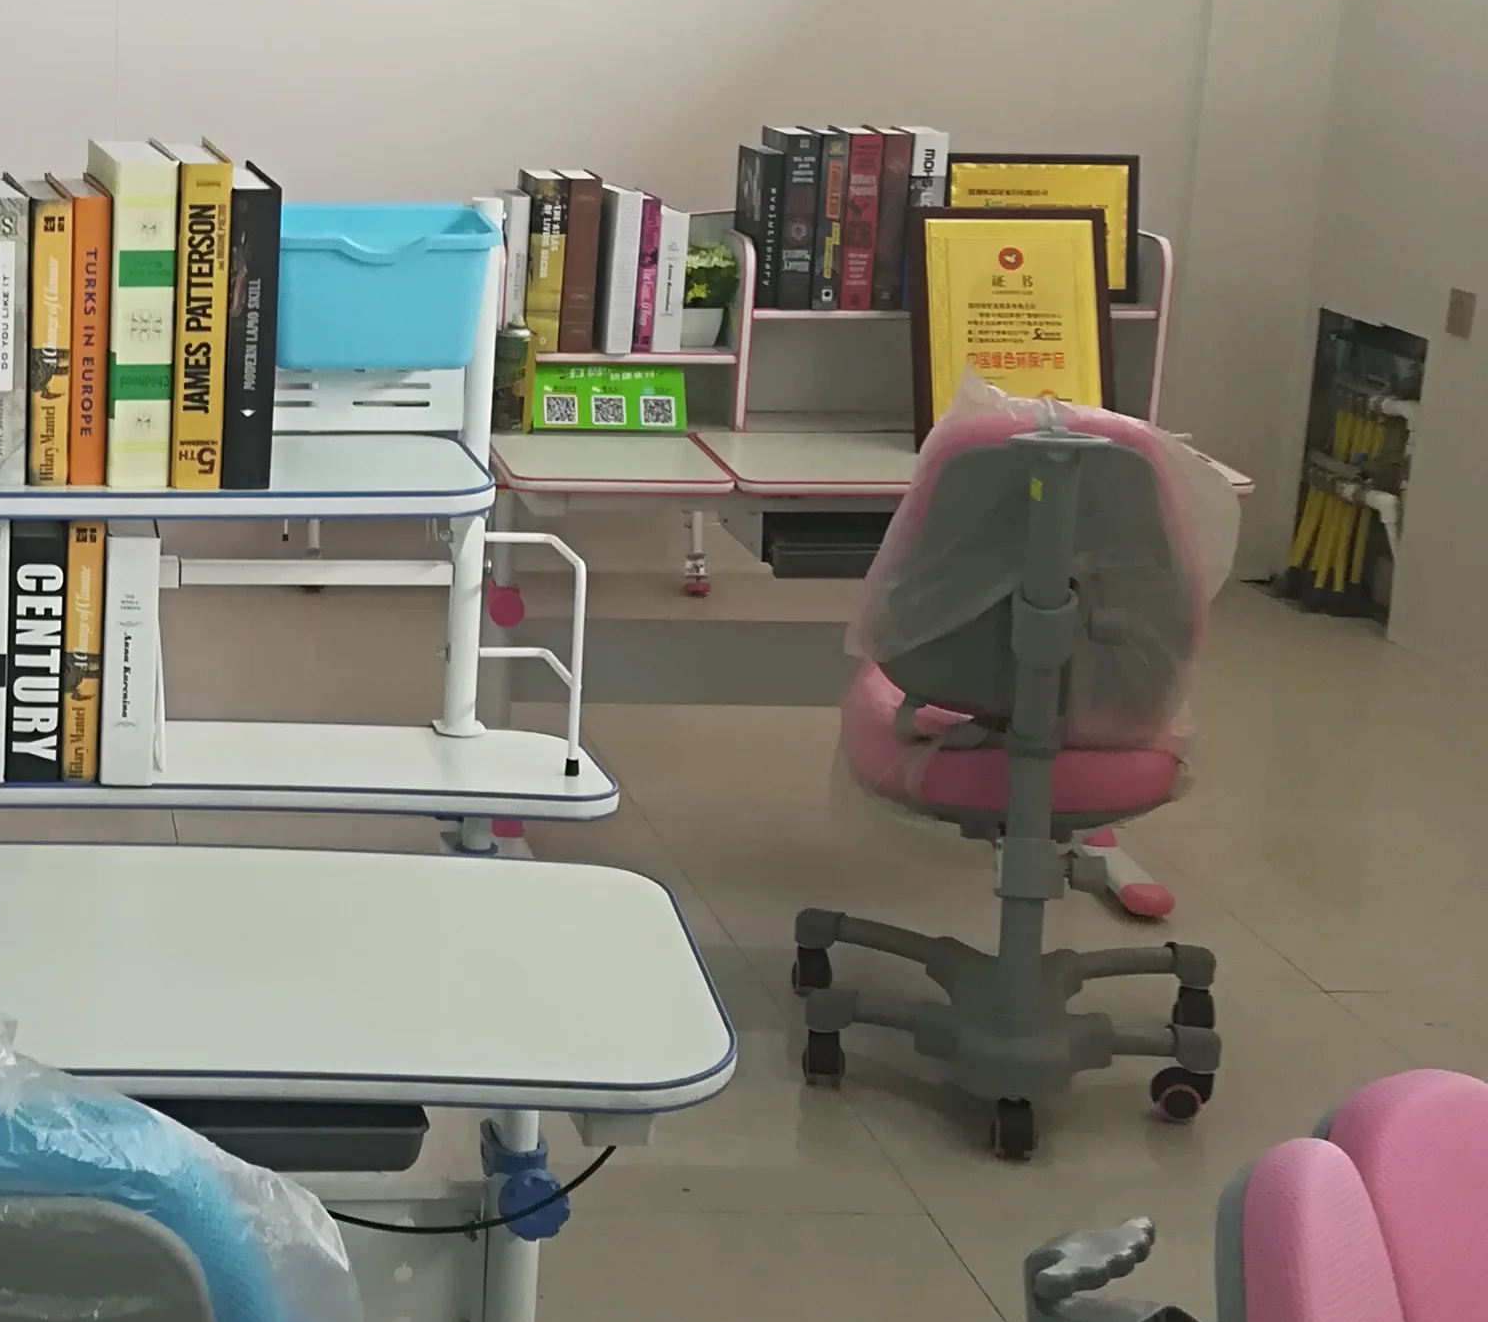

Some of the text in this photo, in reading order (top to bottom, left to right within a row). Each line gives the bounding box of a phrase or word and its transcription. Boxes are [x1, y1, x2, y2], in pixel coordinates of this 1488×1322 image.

[541, 217, 552, 248] LIVING
[550, 203, 562, 252] THE ATLAS
[186, 204, 217, 333] PATTERSON
[247, 278, 261, 310] SKILL
[992, 274, 1033, 288] 证书
[1, 274, 10, 370] DO YOU LIKE IT
[79, 248, 98, 438] TURKS IN EUROPE
[182, 342, 212, 414] JAMES
[967, 351, 1065, 369] 中国绿色环保产品
[39, 405, 59, 482] Hilary Mantel
[11, 563, 64, 762] CENTURY
[68, 706, 89, 779] Hilary Mantel
